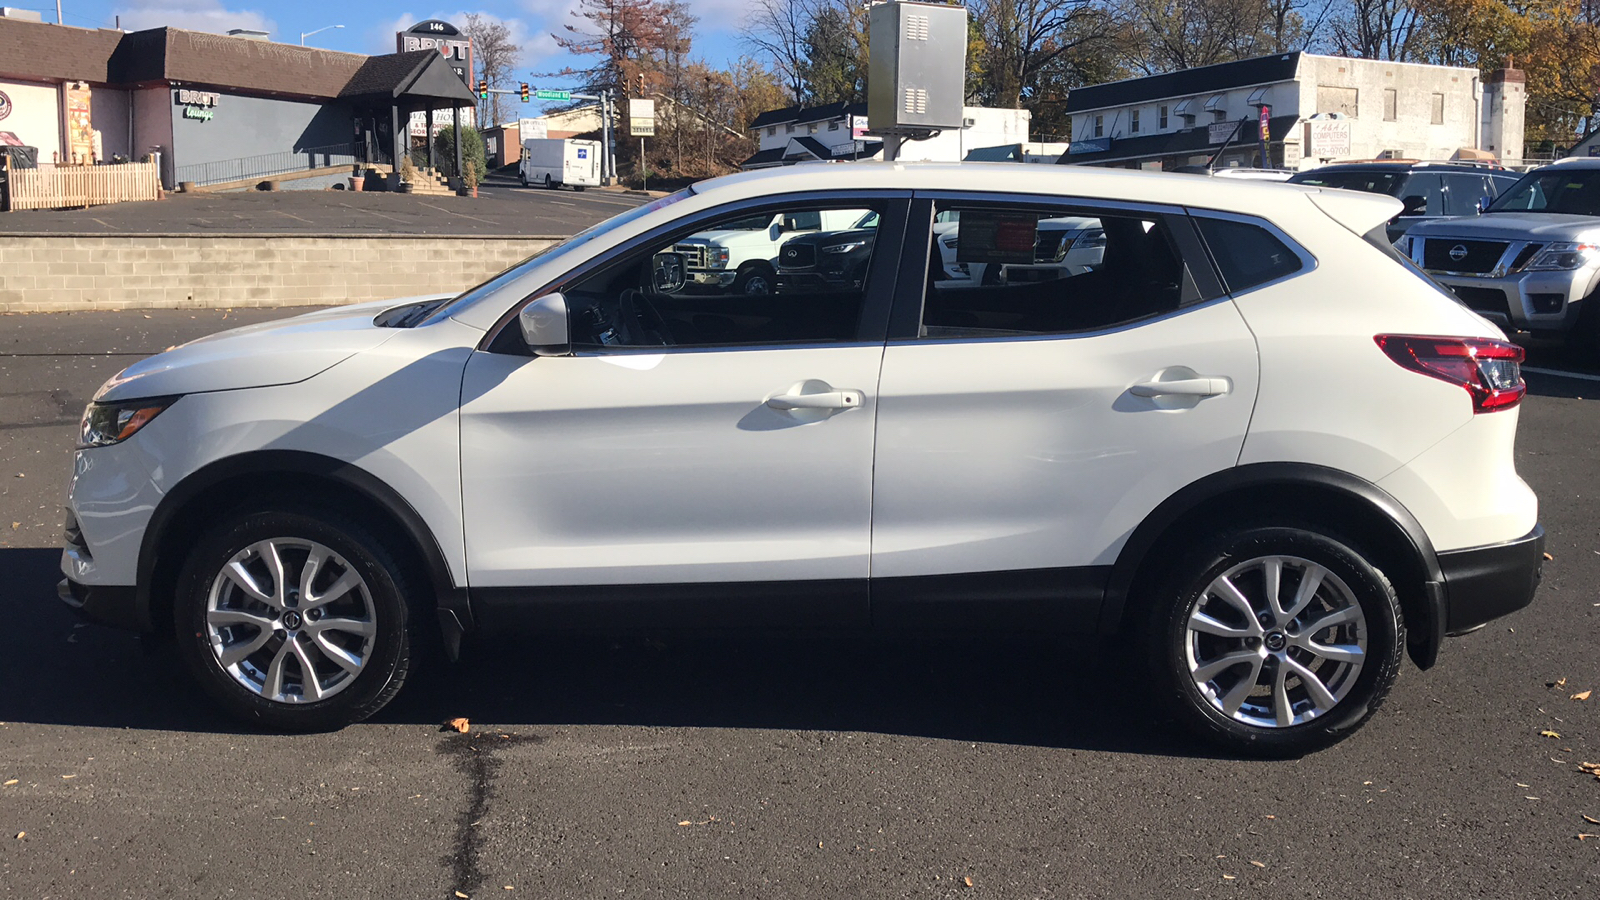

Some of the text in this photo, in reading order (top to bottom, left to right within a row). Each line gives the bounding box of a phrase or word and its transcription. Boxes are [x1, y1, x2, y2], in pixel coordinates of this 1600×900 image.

[404, 37, 469, 59] BRUT
[180, 89, 220, 106] BRUT
[1313, 131, 1348, 140] COMPUTERS
[1312, 146, 1349, 155] 942-9700
